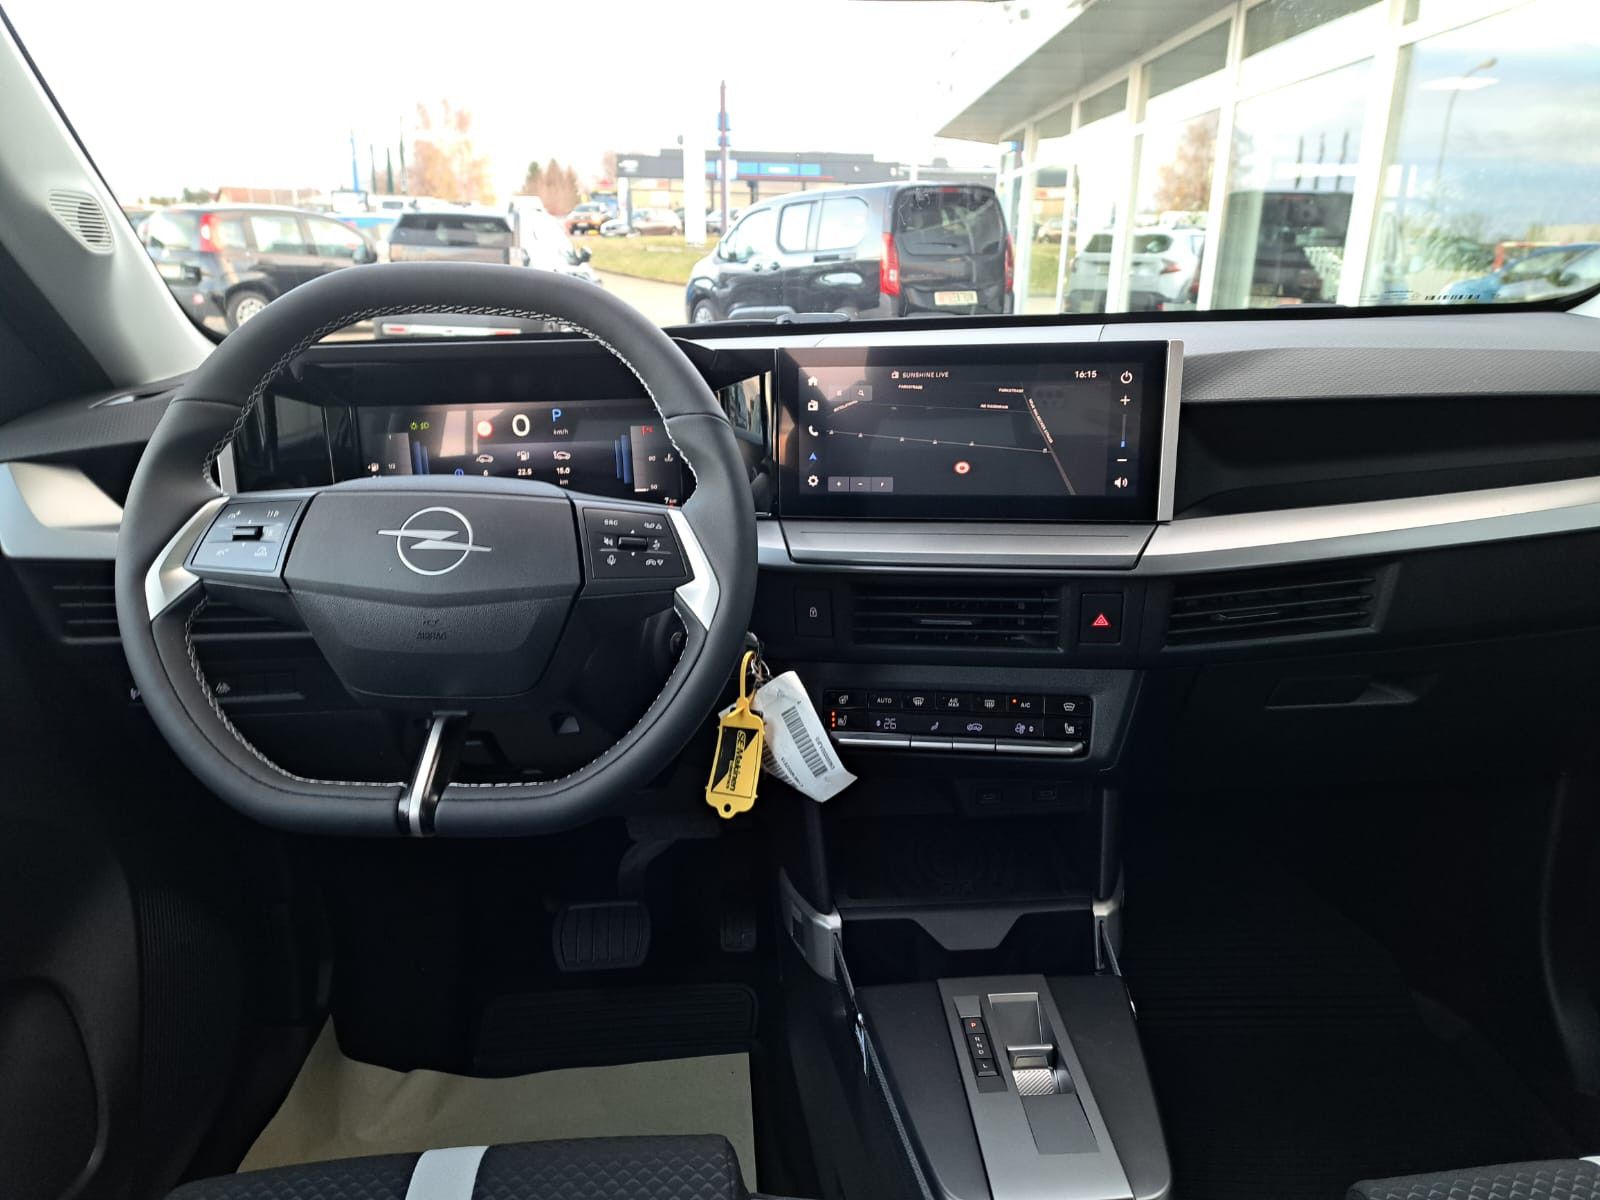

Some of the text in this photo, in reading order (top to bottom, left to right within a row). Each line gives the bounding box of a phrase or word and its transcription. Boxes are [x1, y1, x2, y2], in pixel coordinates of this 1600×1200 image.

[902, 371, 934, 379] SUNSHINE
[1074, 369, 1097, 379] 16:15
[552, 408, 562, 423] P
[511, 413, 531, 437] 0
[553, 428, 569, 436] km/h
[883, 717, 897, 730] 26
